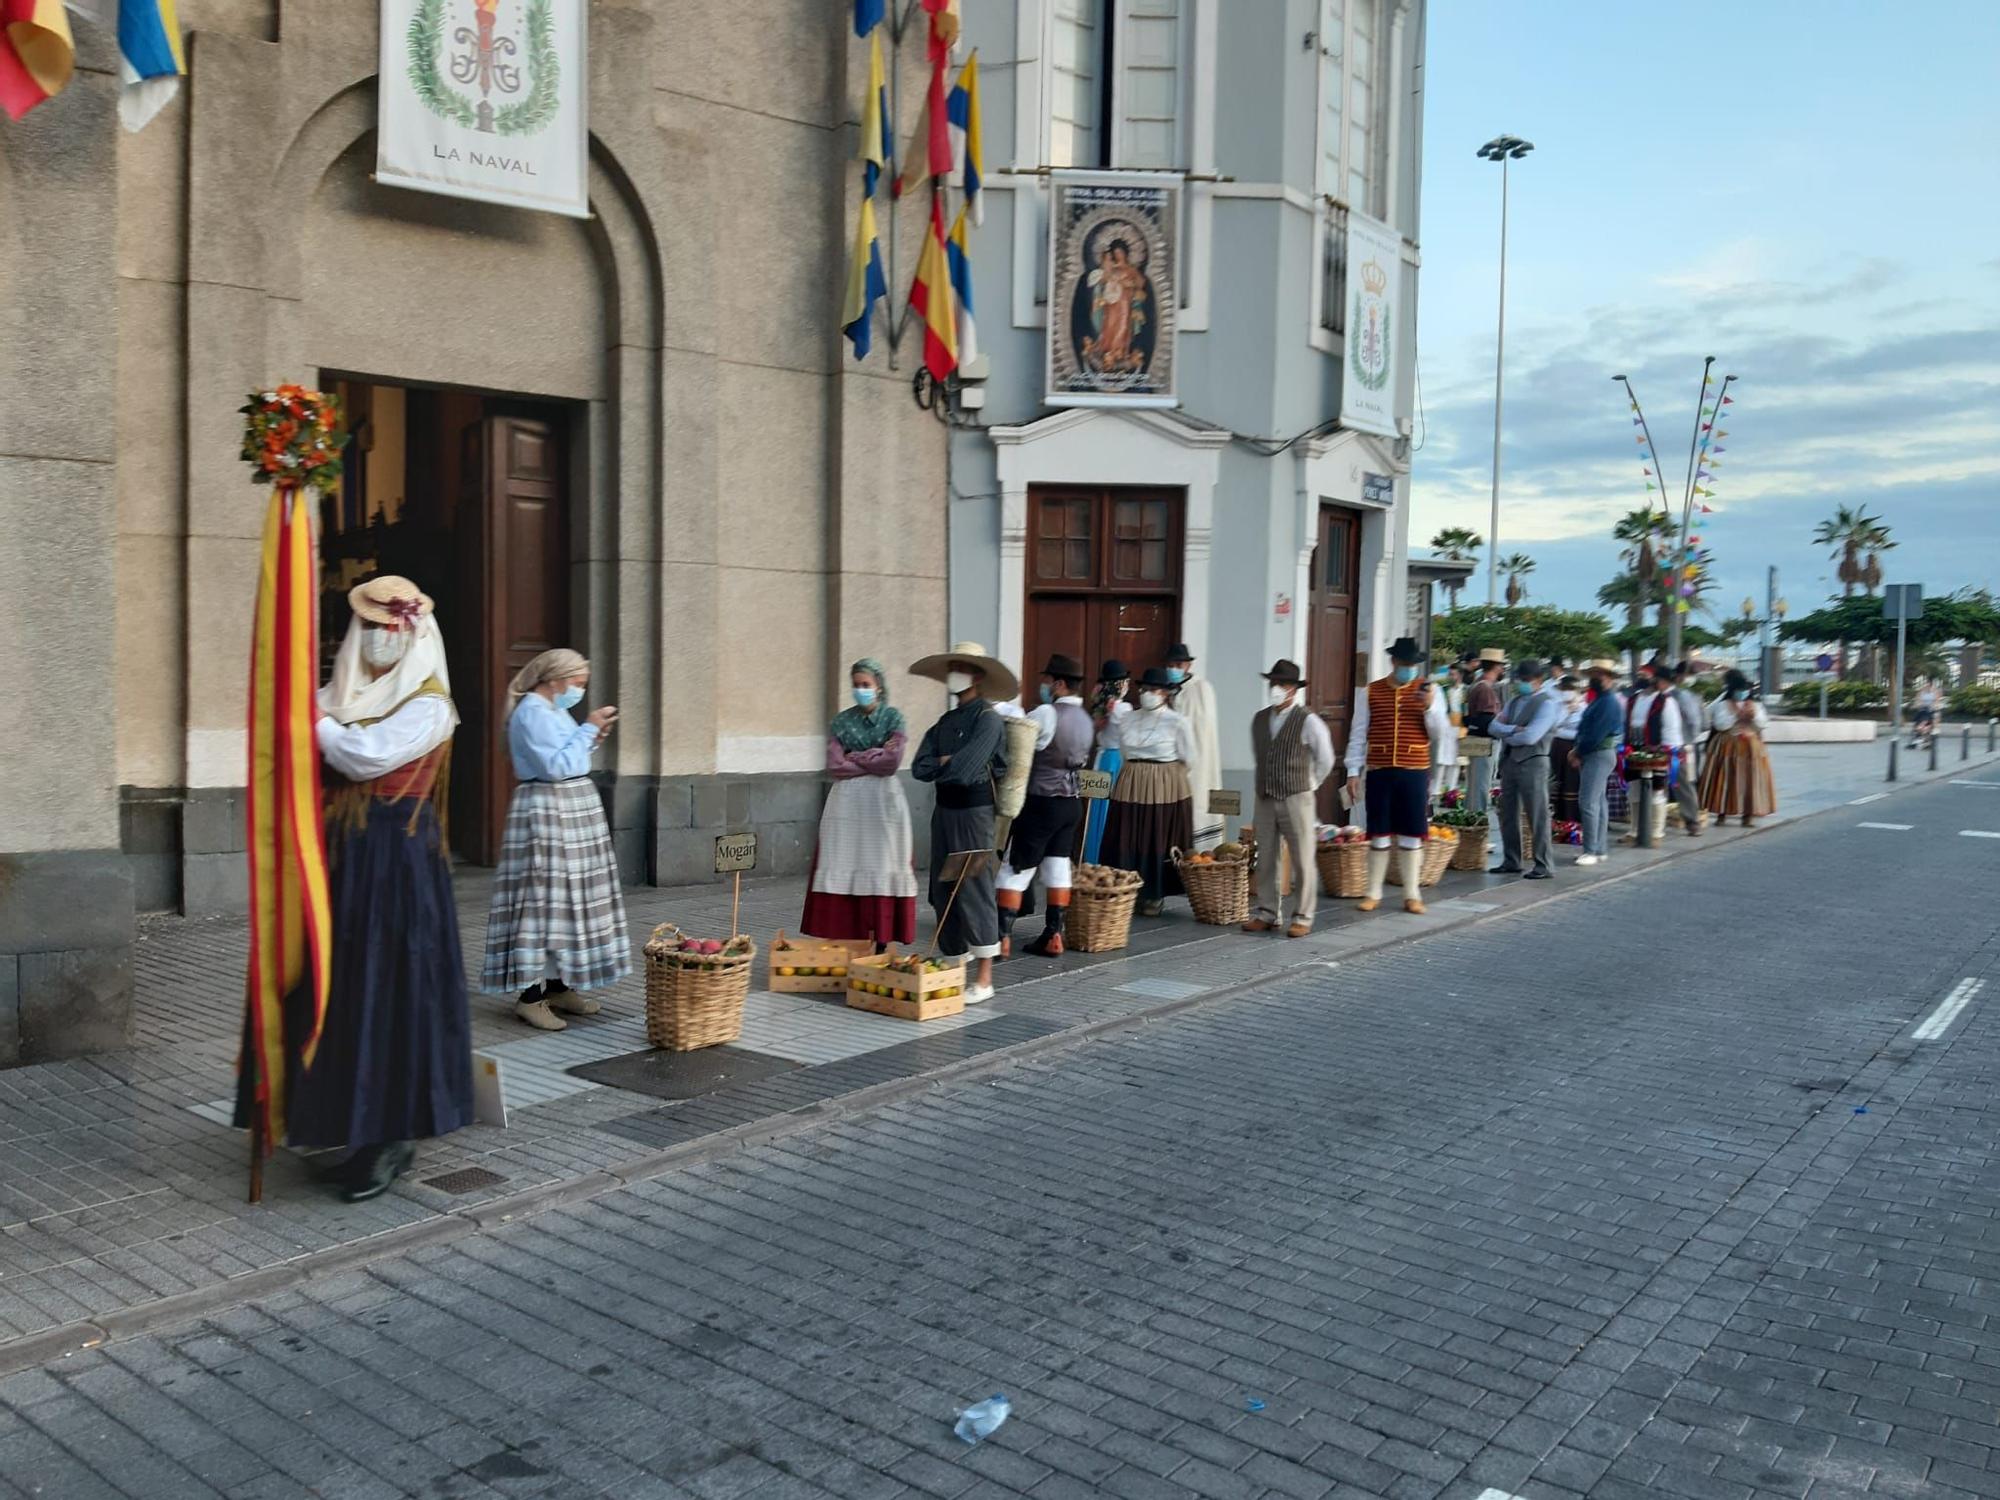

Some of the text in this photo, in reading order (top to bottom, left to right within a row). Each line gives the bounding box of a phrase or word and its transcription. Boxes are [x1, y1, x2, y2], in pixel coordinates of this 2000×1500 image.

[434, 144, 538, 176] LA NAVAL
[1080, 776, 1109, 790] ejeda
